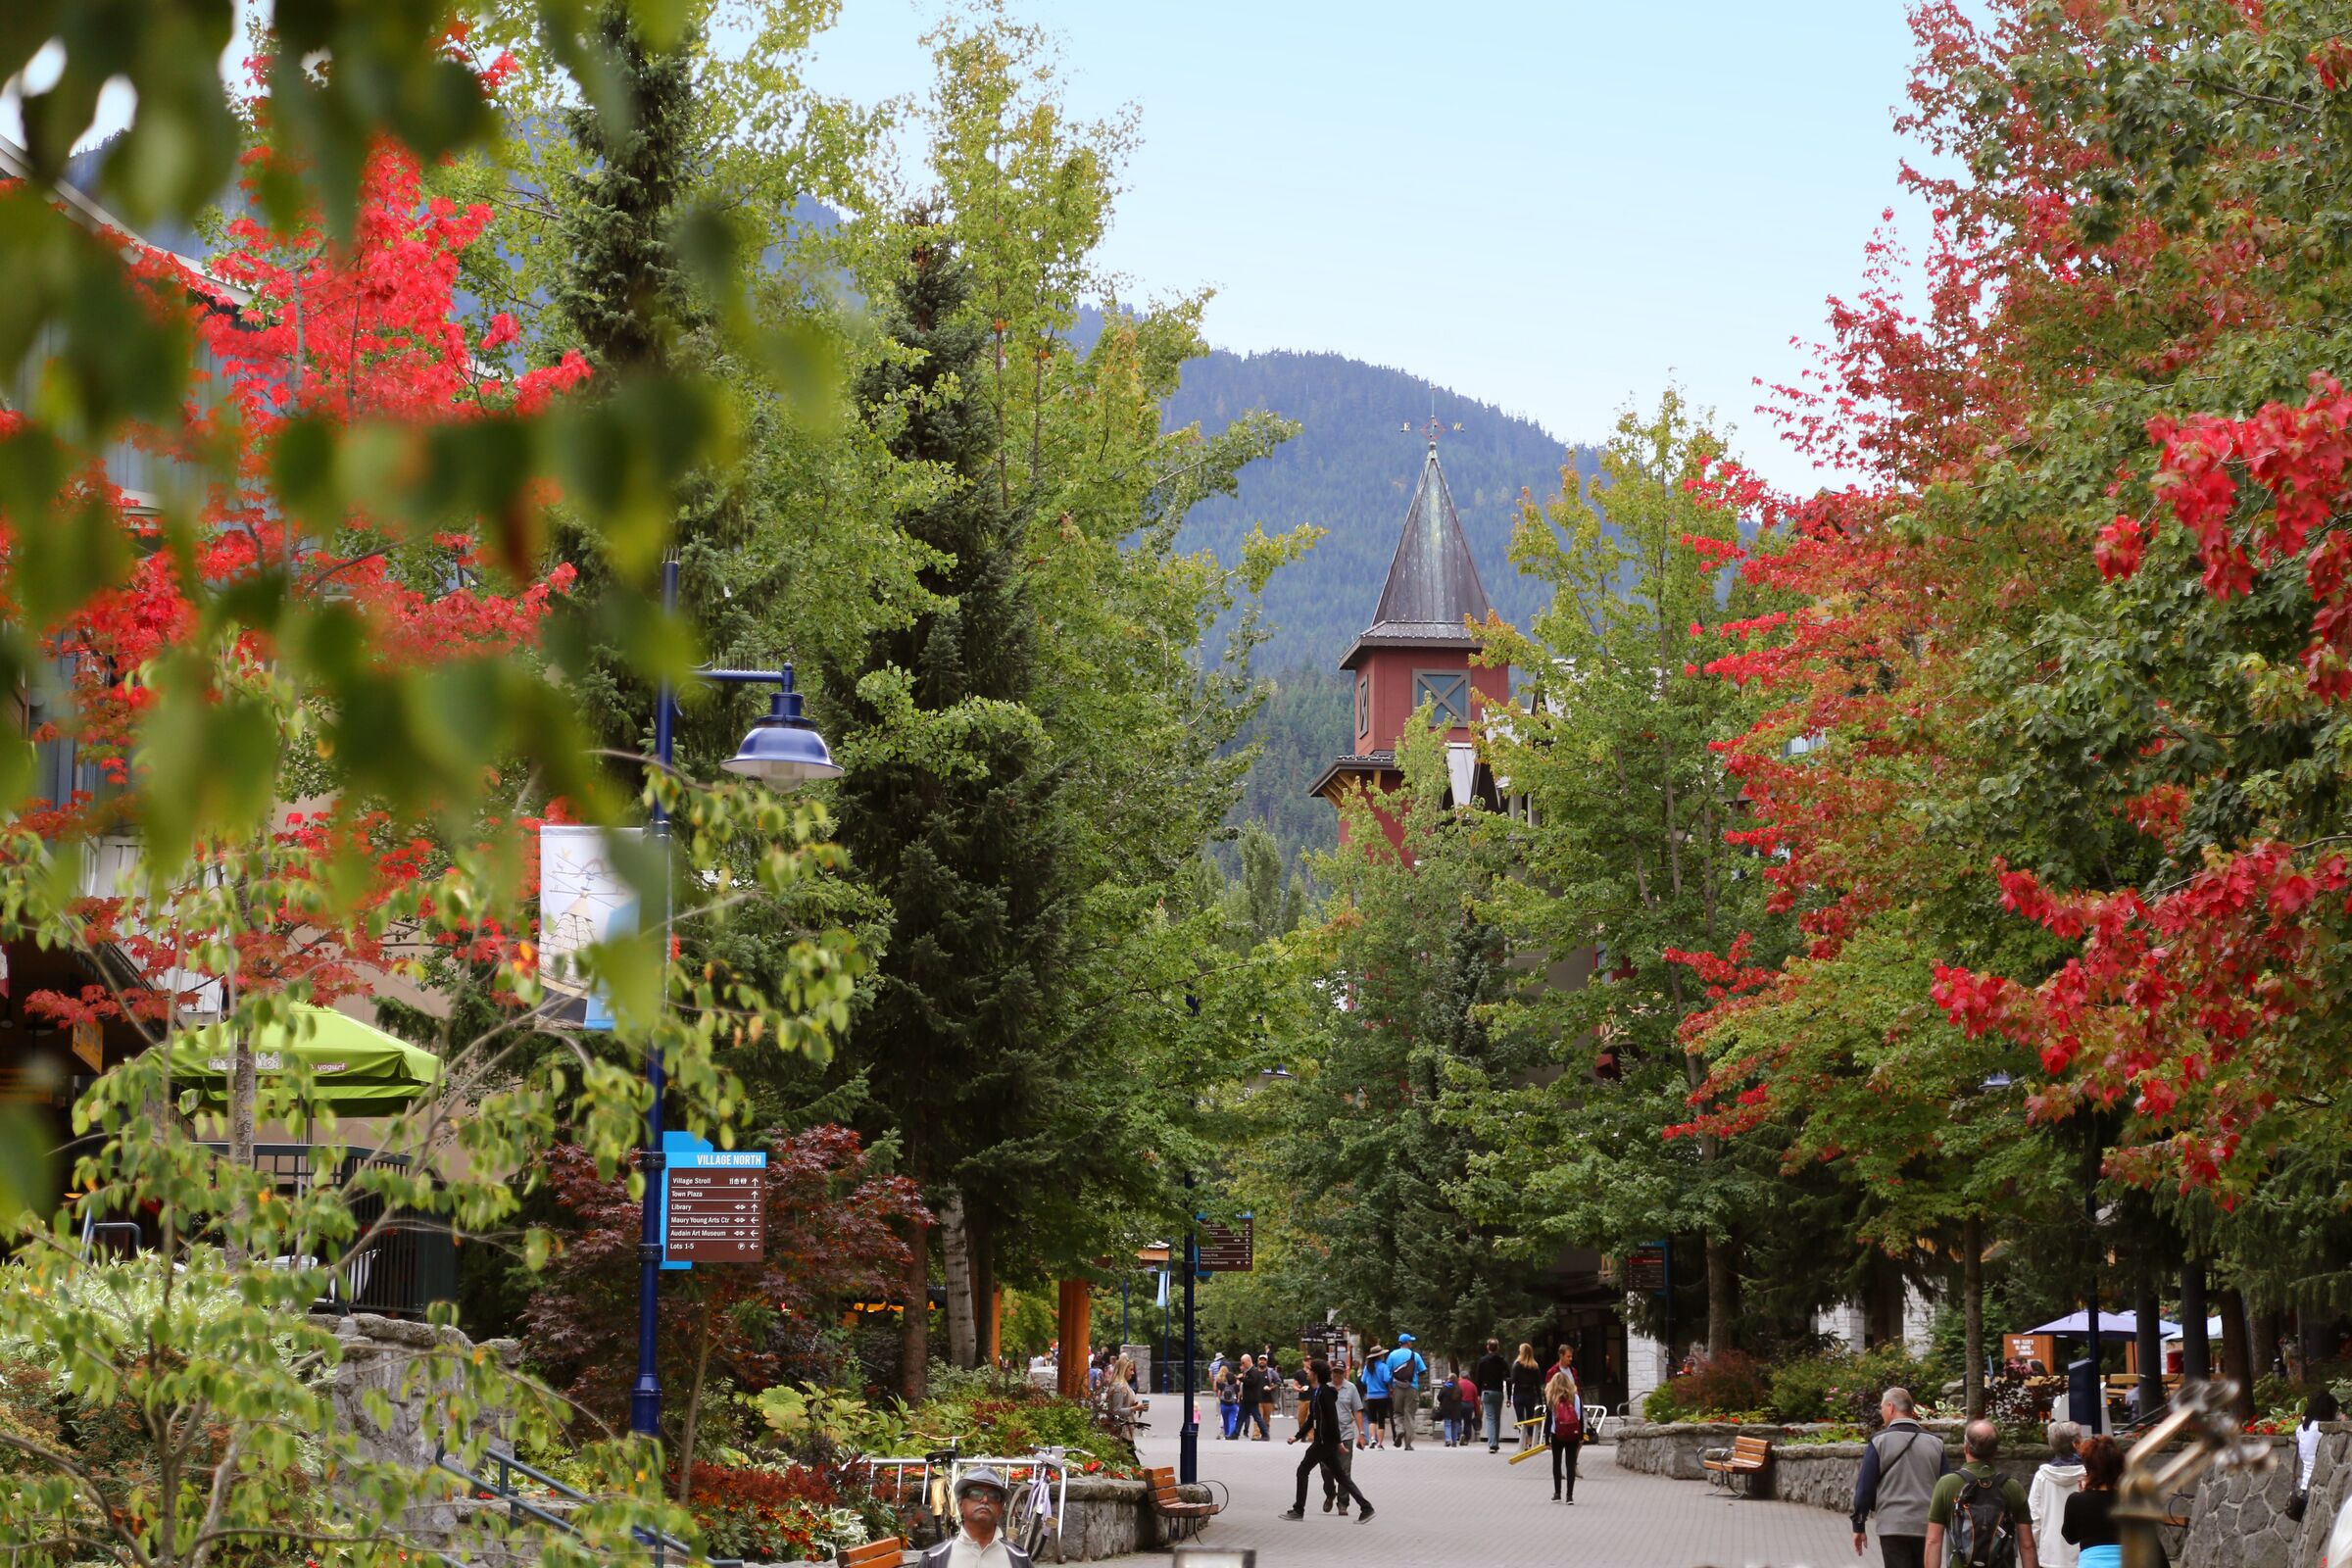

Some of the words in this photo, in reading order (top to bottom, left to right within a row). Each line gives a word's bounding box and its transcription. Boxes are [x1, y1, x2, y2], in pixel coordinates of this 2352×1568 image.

[317, 1062, 345, 1071] yogurt
[697, 1154, 732, 1165] VILLAGE
[733, 1154, 761, 1165] NORTH
